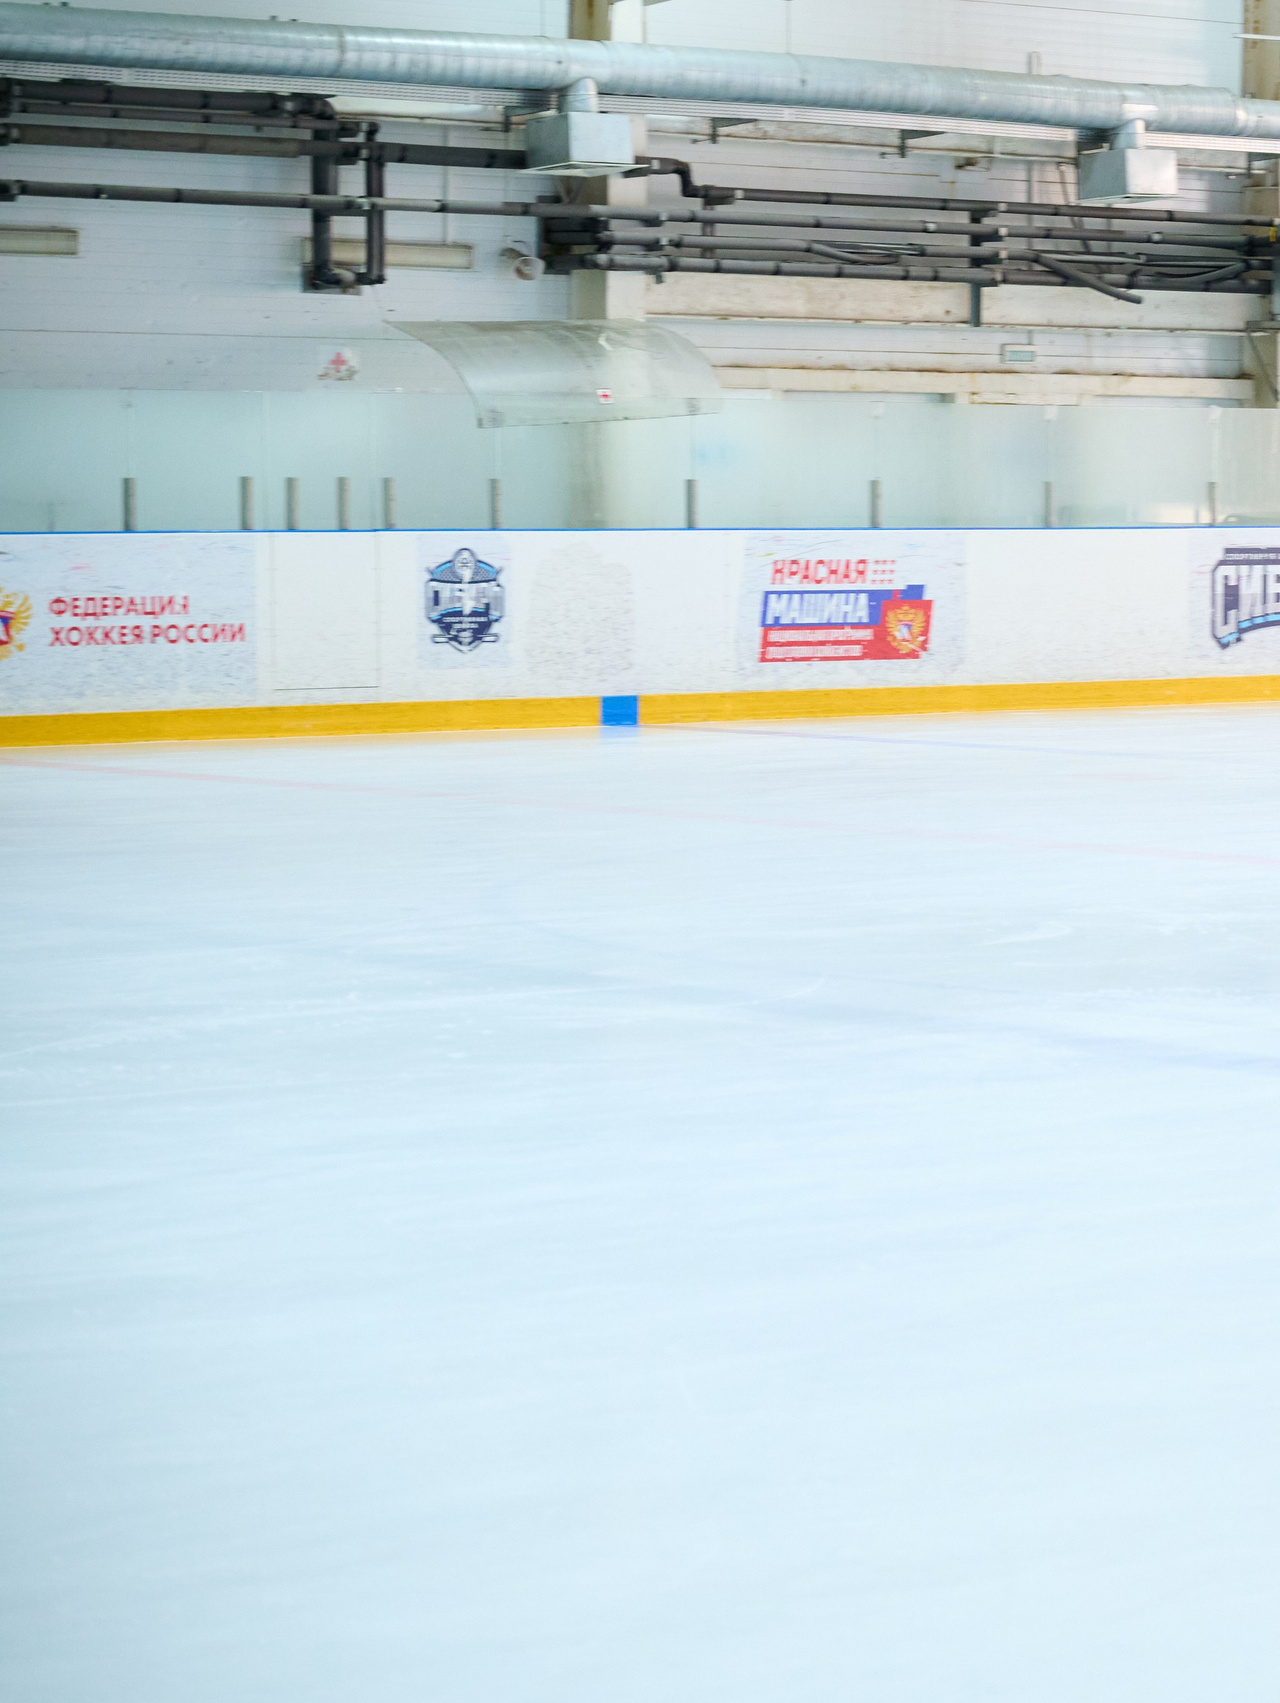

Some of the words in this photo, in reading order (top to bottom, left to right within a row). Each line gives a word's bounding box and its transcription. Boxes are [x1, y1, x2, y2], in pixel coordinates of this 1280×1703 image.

[770, 558, 869, 585] КРАСНАЯ
[48, 595, 190, 620] ФЕДЕРАЦИЯ
[765, 592, 870, 625] МАШИНА
[49, 624, 143, 647] ХОККЕЯ
[151, 622, 246, 645] РОССИИ
